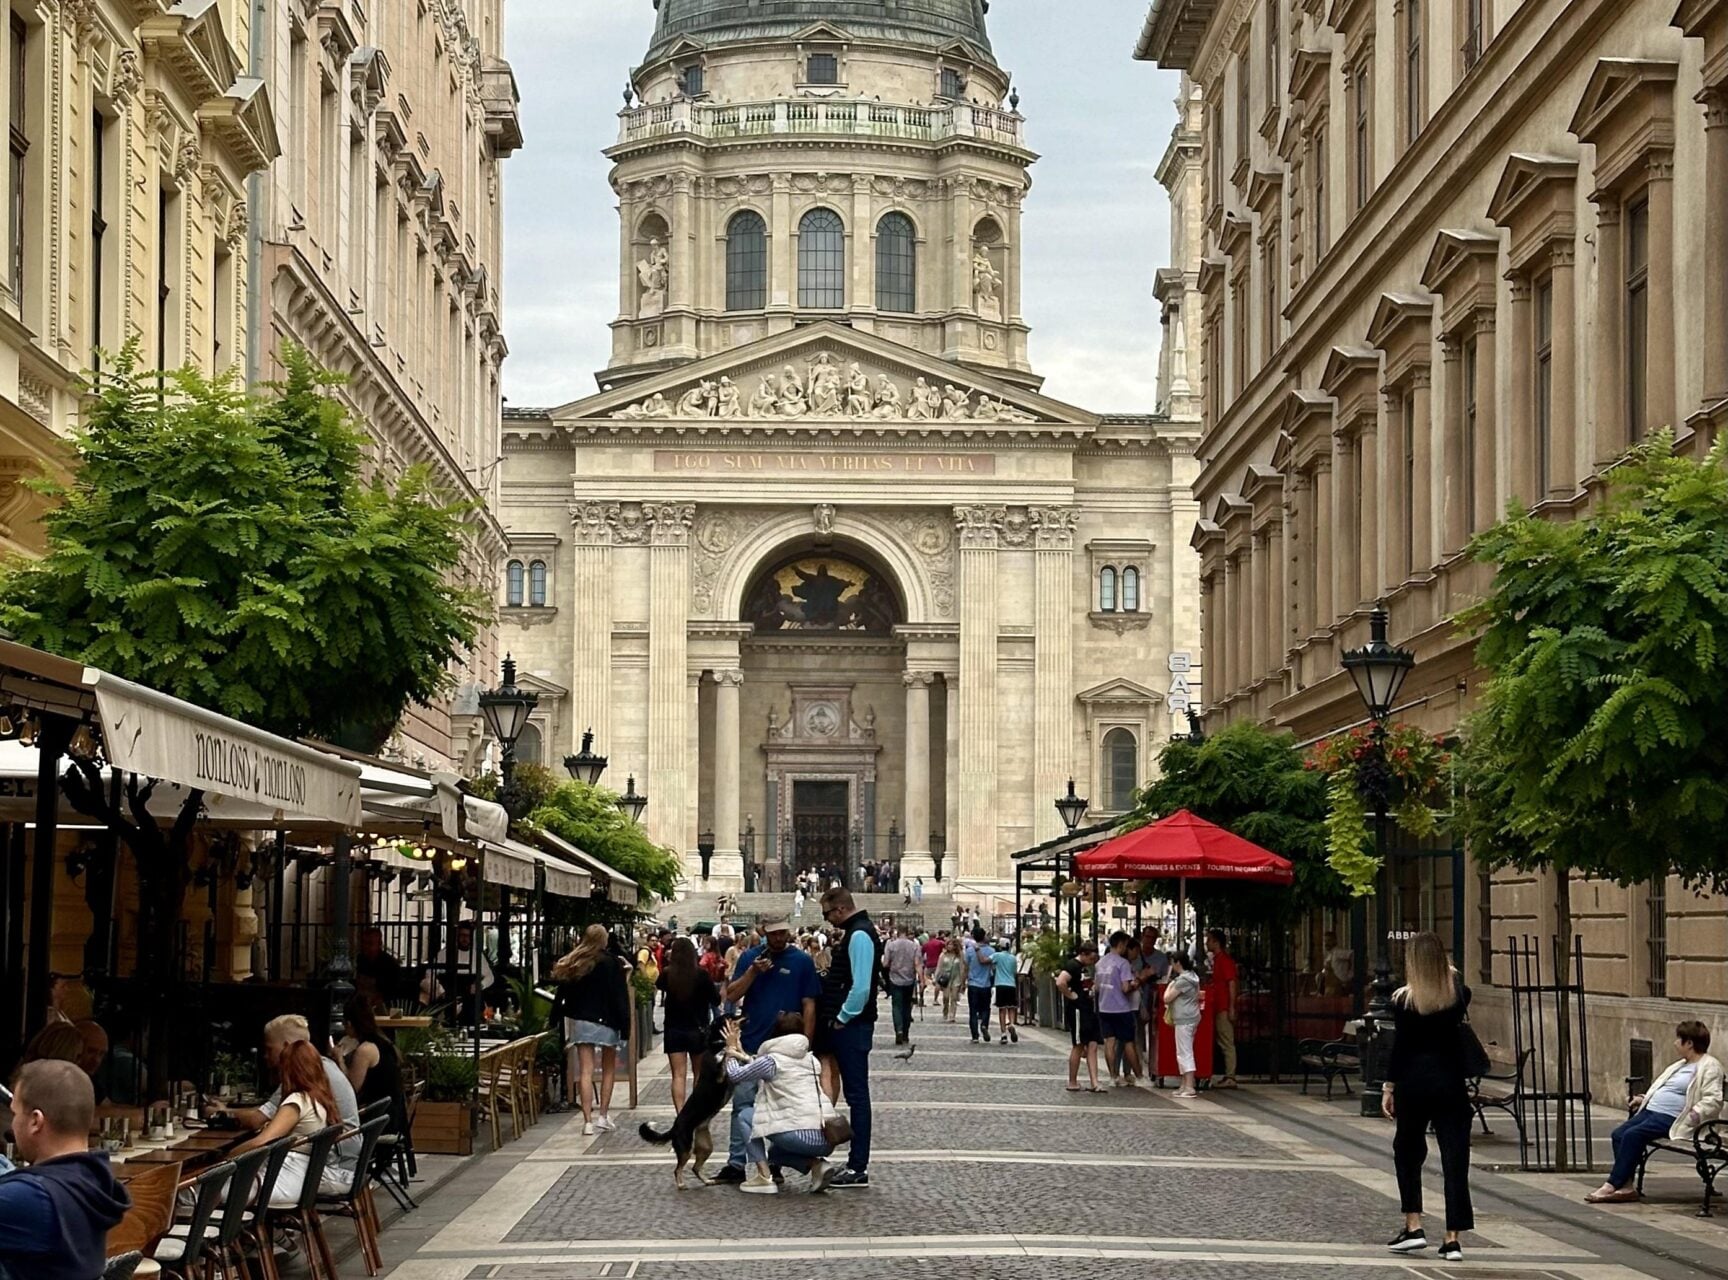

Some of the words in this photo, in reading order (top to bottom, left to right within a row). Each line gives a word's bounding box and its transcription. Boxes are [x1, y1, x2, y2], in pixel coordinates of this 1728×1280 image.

[673, 454, 711, 469] EGO
[723, 454, 762, 469] SUM
[1175, 863, 1200, 871] EVENTS
[1207, 864, 1233, 872] TOURIST
